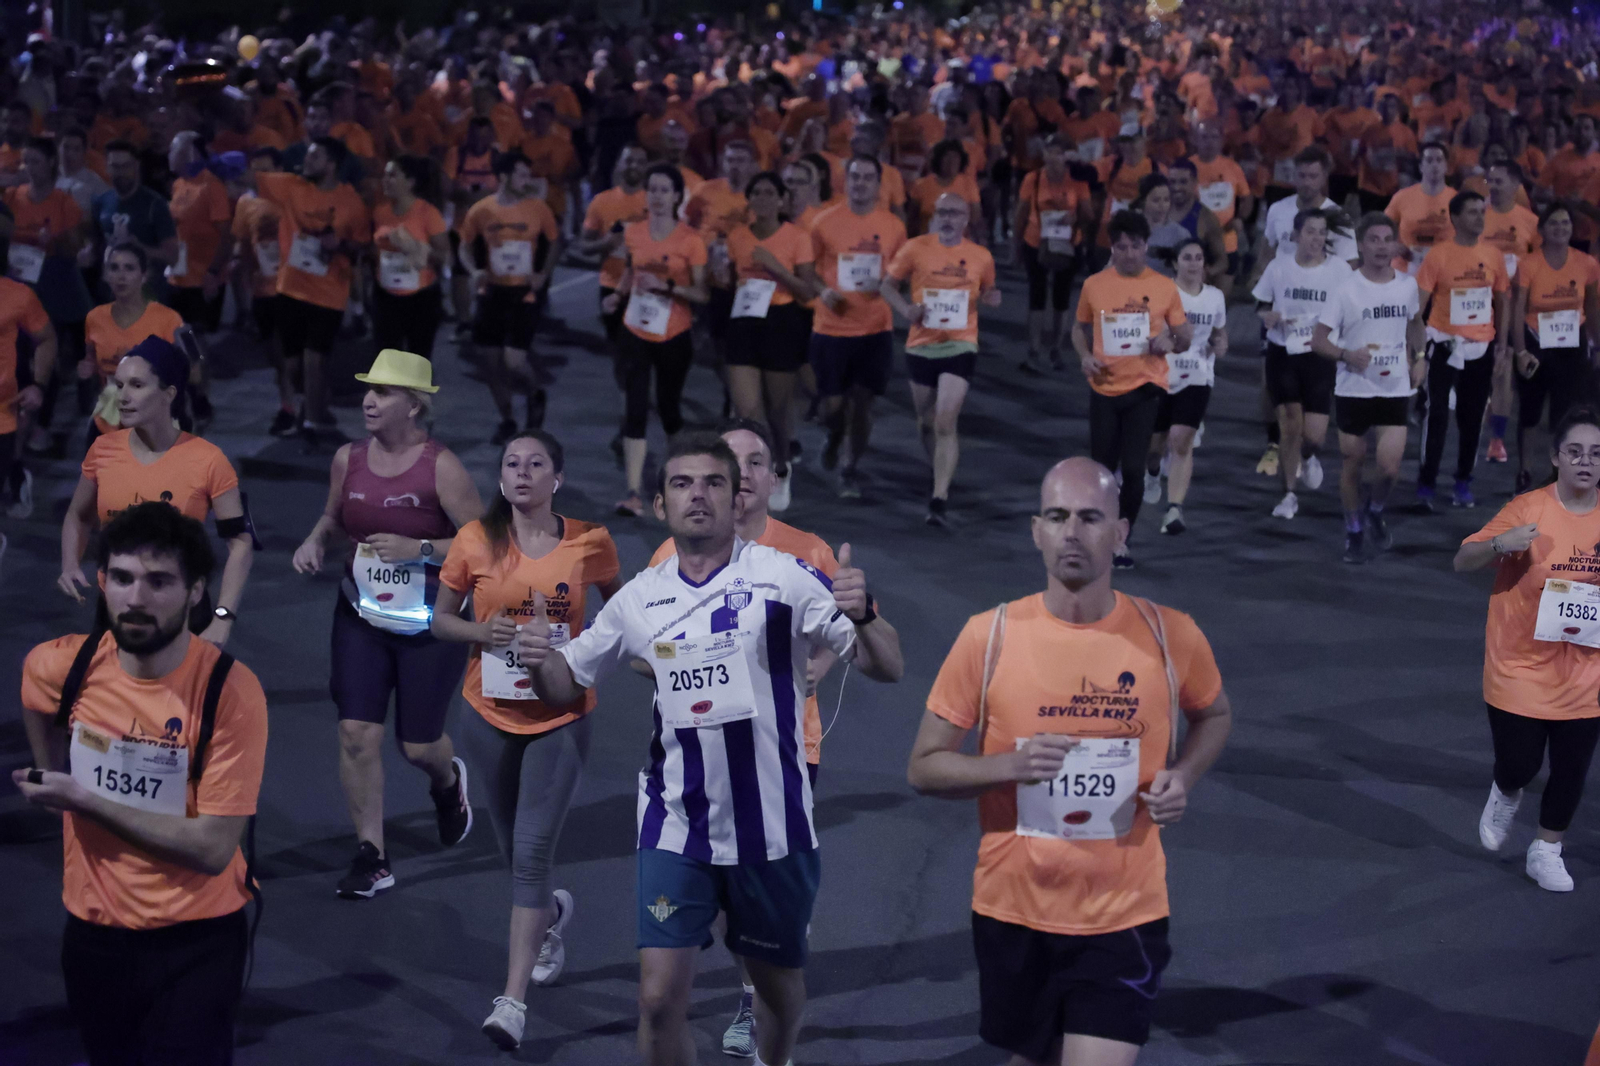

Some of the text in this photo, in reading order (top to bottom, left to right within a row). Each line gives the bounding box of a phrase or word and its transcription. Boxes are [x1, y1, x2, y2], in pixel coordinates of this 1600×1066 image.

[1112, 327, 1141, 339] 18649
[1373, 355, 1400, 367] 18271
[367, 567, 410, 584] 14060
[521, 600, 571, 609] NOTURNA
[1558, 602, 1597, 621] 15382
[669, 664, 730, 691] 20573
[1070, 695, 1140, 707] NOCTURNA
[1038, 706, 1137, 721] SEVILLA KH7
[94, 765, 162, 799] 15347
[1049, 774, 1115, 796] 11529
